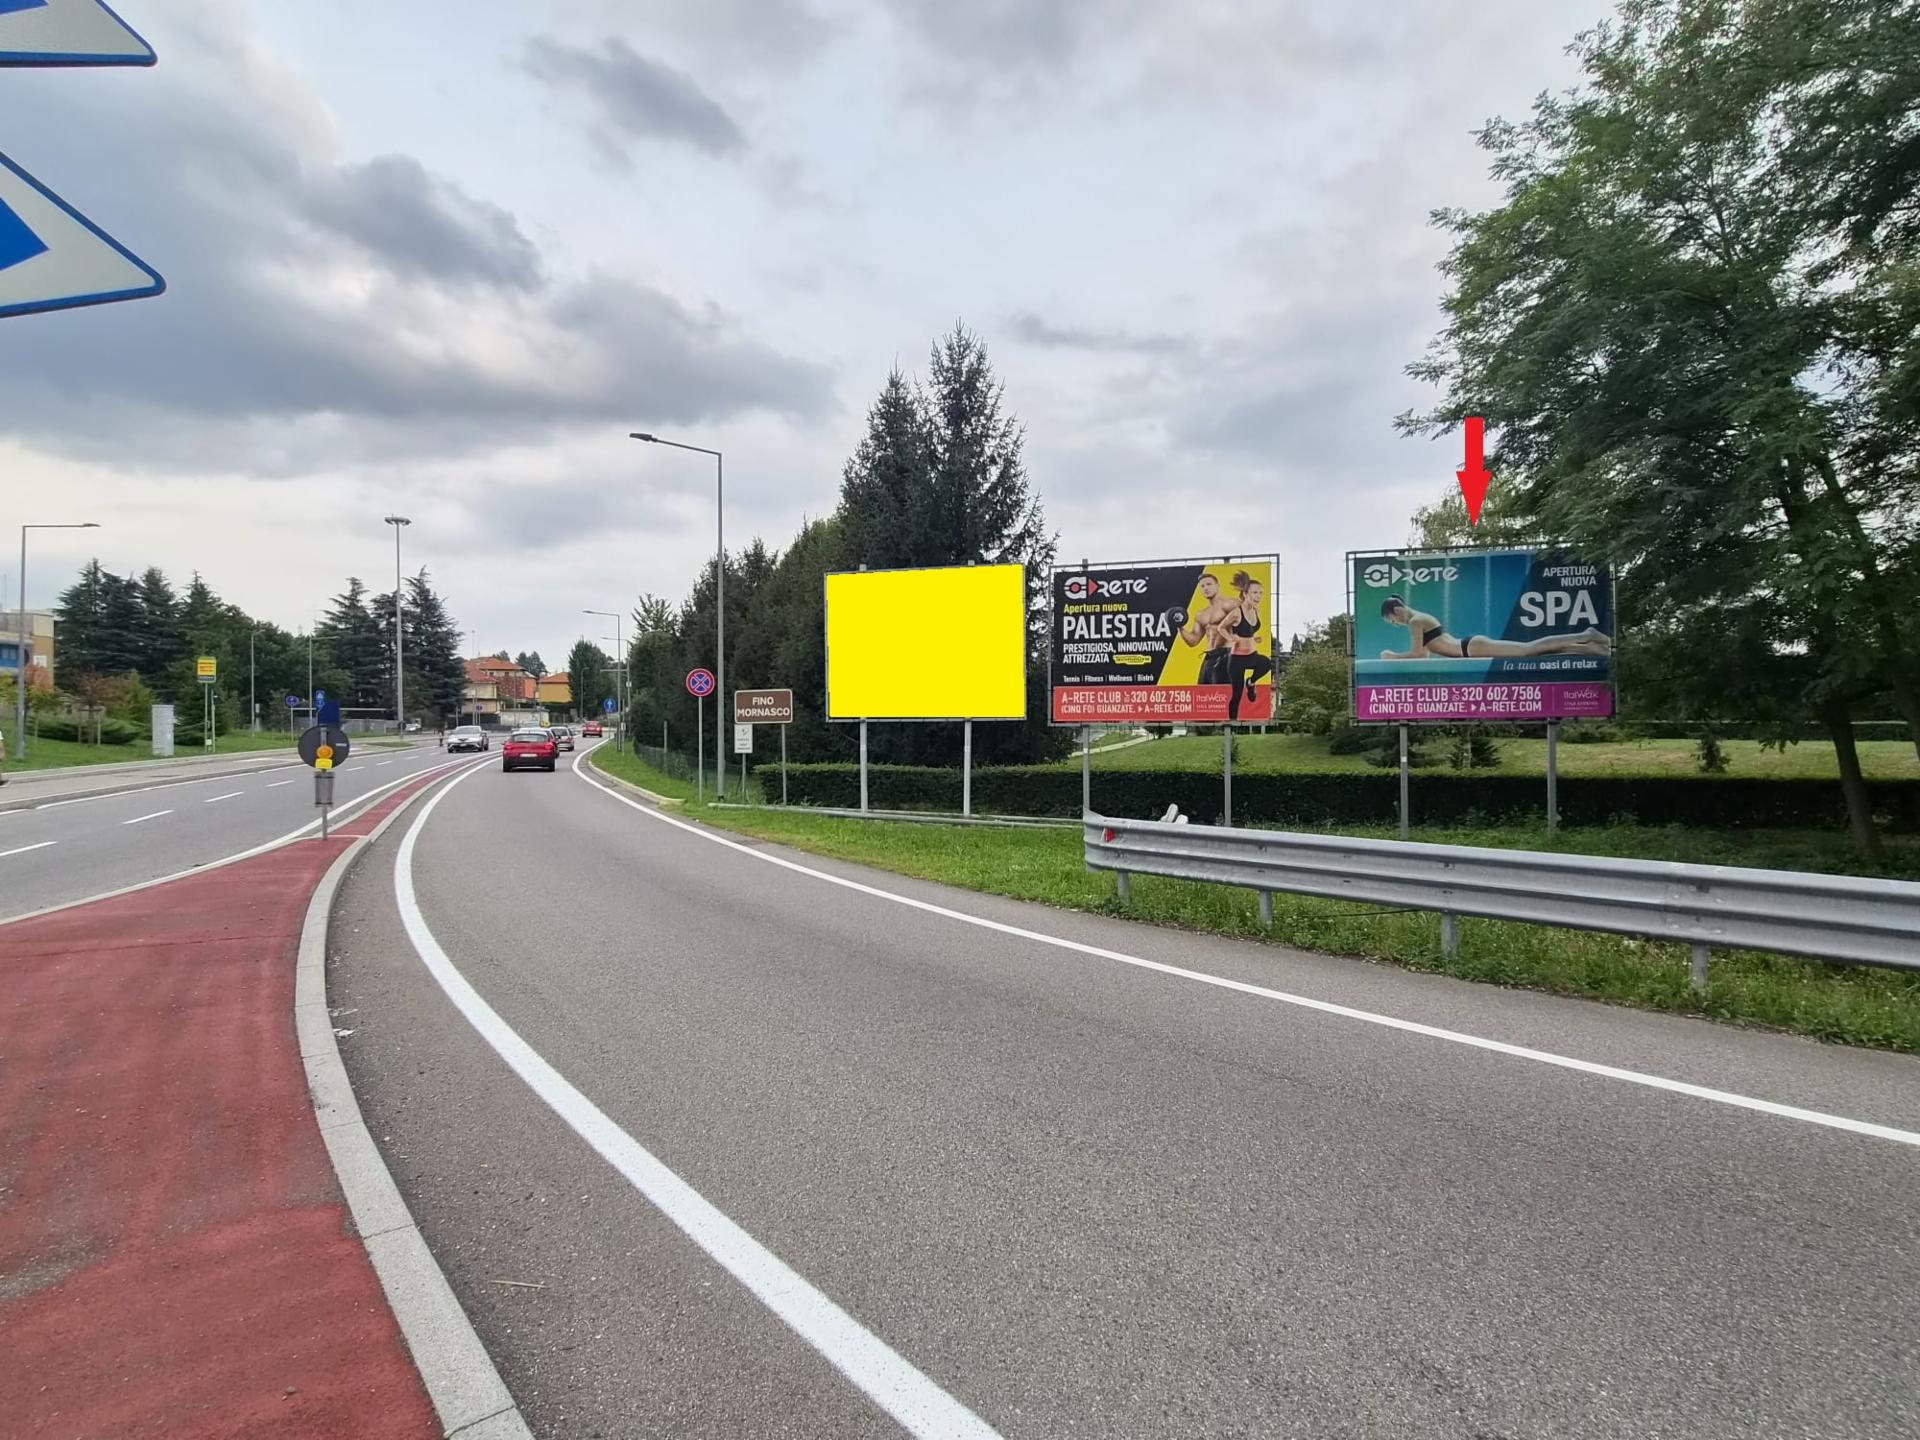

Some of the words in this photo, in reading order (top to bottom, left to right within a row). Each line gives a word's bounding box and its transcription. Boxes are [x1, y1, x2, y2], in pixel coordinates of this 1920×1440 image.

[1542, 566, 1596, 578] APERTURA
[1560, 576, 1597, 588] NUOVA
[1063, 604, 1100, 614] Apertura
[1102, 603, 1128, 612] nuova
[1520, 590, 1599, 628] SPA
[1063, 612, 1172, 640] PALESTRA
[1063, 642, 1116, 654] PRESTIGIOSA,
[1118, 641, 1168, 652] INNOVATIVA,
[1062, 653, 1110, 664] ATTREZZATA
[1503, 660, 1514, 670] la
[1518, 662, 1536, 670] tua
[1540, 660, 1560, 670] oasi
[1562, 660, 1570, 669] di
[1572, 659, 1598, 668] relax
[1108, 674, 1132, 682] Wellness
[1062, 692, 1095, 704] A-RETE
[1098, 691, 1121, 703] CLUB
[1130, 691, 1147, 703] 320
[1150, 691, 1166, 703] 602
[1169, 690, 1192, 702] 7586
[1370, 688, 1414, 702] A-RETE
[1418, 688, 1448, 701] CLUB
[1462, 687, 1483, 701] 320
[1487, 687, 1508, 701] 602
[1512, 686, 1541, 700] 7586
[752, 696, 774, 706] FINO
[1417, 702, 1467, 712] GUANZATE.
[1480, 701, 1542, 712] A-RETE.COM
[737, 707, 790, 717] MORNASCO
[1144, 704, 1192, 713] A-RETE.COM
